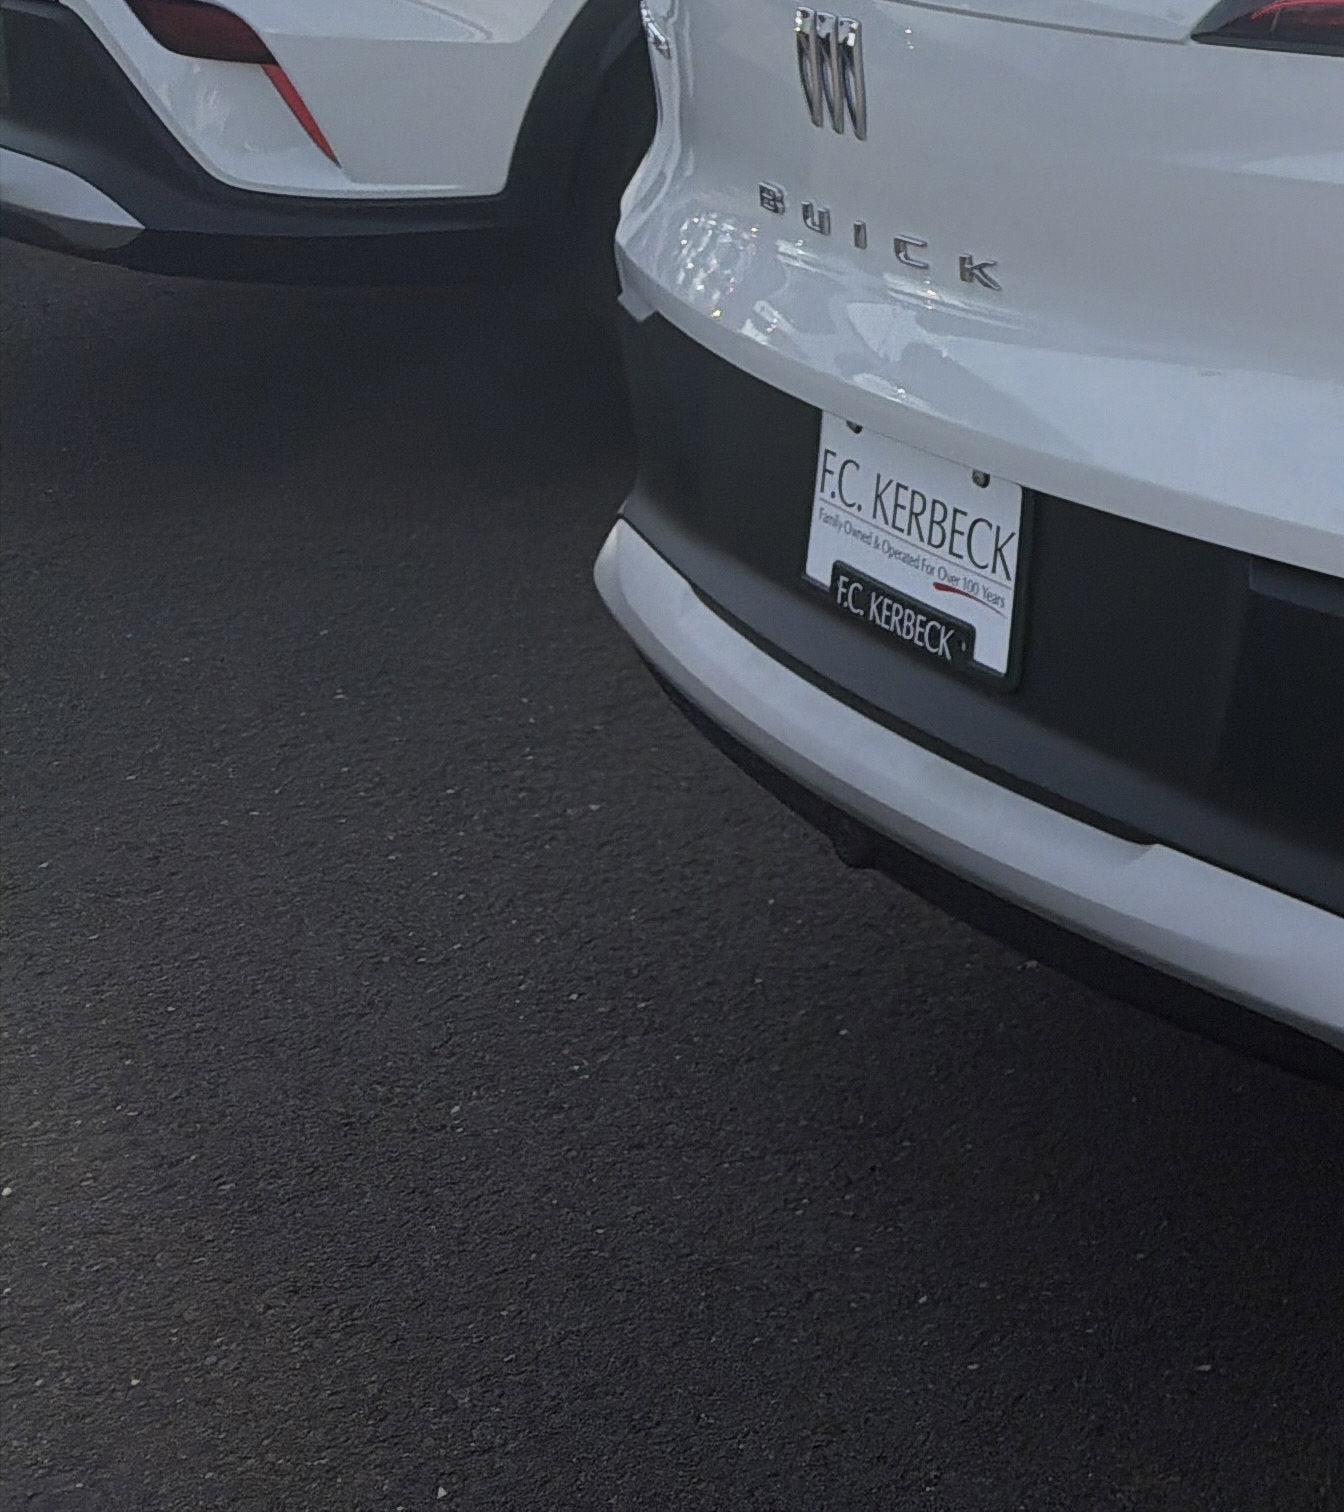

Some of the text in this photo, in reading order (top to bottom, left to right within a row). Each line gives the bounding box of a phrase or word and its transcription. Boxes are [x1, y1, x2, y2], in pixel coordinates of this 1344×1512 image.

[759, 181, 1002, 290] BUICK
[819, 507, 843, 534] Family
[844, 520, 873, 546] Owned
[882, 539, 920, 570] Operated
[922, 558, 935, 576] For
[937, 566, 960, 586] Over
[963, 577, 979, 595] 100
[983, 585, 1005, 607] Years
[820, 448, 1016, 581] F.C. KERBECK
[836, 575, 956, 660] F.C. KERBECK
